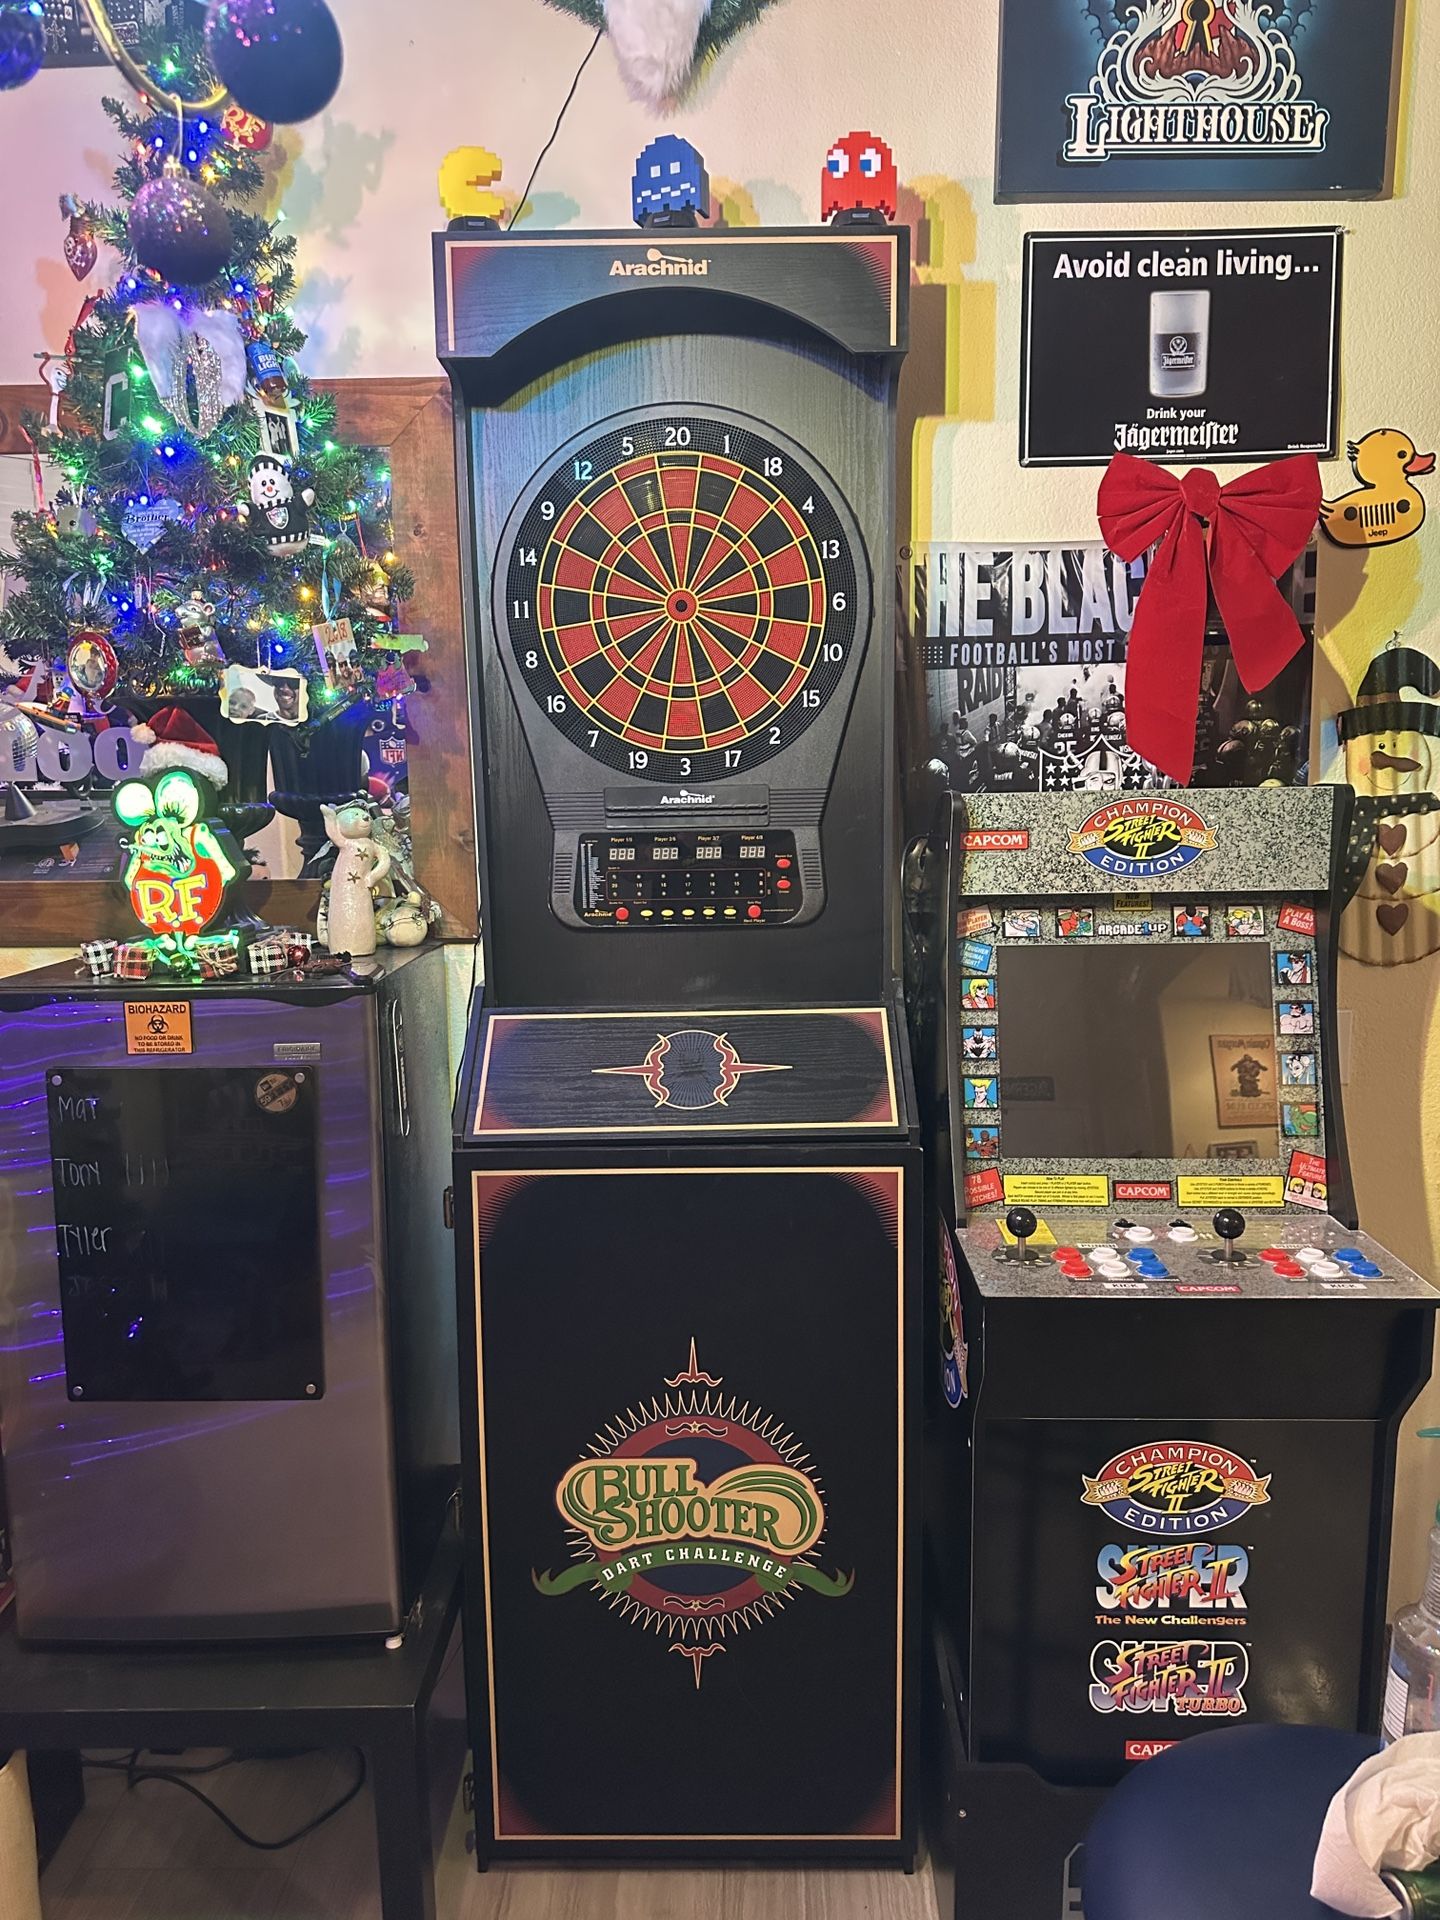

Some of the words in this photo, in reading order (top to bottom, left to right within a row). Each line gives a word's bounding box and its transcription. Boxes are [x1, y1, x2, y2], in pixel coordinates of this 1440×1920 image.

[1067, 97, 1327, 158] LIGHTHOUSE
[608, 258, 709, 277] Arachnid
[1053, 250, 1130, 279] Avoid
[1137, 250, 1208, 277] clean
[1216, 248, 1319, 280] living...
[258, 360, 280, 371] LIGH
[1146, 407, 1177, 420] Drink
[1180, 408, 1206, 421] your
[621, 436, 634, 454] 5
[663, 426, 691, 447] 20
[723, 434, 731, 453] 1
[574, 460, 592, 480] 12
[763, 456, 783, 476] 18
[540, 501, 555, 521] 9
[802, 495, 815, 514] 4
[1368, 529, 1388, 537] Jeep
[518, 547, 537, 567] 14
[821, 539, 840, 559] 13
[832, 592, 847, 611] 6
[1012, 549, 1146, 635] BLAC
[513, 600, 530, 619] 11
[525, 650, 539, 669] 8
[822, 643, 844, 662] 10
[950, 641, 1058, 666] FOOTBALL'S
[1068, 639, 1116, 663] MOST
[546, 694, 566, 713] 16
[802, 689, 820, 708] 15
[587, 729, 600, 748] 7
[769, 727, 781, 745] 2
[628, 751, 648, 770] 19
[680, 757, 691, 776] 3
[724, 750, 742, 768] 17
[660, 794, 713, 805] Arachnid
[1093, 802, 1193, 828] CHAMPION
[1103, 814, 1155, 843] STREET
[1121, 821, 1181, 846] FIGHTER
[963, 834, 1023, 847] CAPCOM
[1100, 853, 1185, 873] EDITION
[1285, 908, 1303, 918] PLAY
[1290, 918, 1314, 930] BOSS!
[128, 1004, 186, 1014] BIOHAZARD
[54, 1158, 101, 1187] Tony
[971, 1174, 982, 1185] 78
[965, 1189, 998, 1205] ATCHES!
[1118, 1186, 1167, 1197] CAPCOM
[58, 1224, 112, 1257] Tyler
[1115, 1447, 1238, 1475] CHAMPION
[1128, 1461, 1193, 1491] STREET
[1141, 1468, 1225, 1497] FIGHTER
[588, 1464, 699, 1515] BULL
[1161, 1494, 1193, 1514] II
[594, 1495, 788, 1550] SHOOTER
[1124, 1507, 1227, 1529] EDITION
[601, 1552, 653, 1582] DART
[665, 1547, 788, 1579] CHALLENGE
[1109, 1543, 1213, 1584] STREET
[1115, 1565, 1204, 1608] FIGHTER
[1095, 1614, 1121, 1625] The
[1125, 1614, 1158, 1625] New
[1161, 1614, 1247, 1625] Challengers
[1104, 1640, 1210, 1684] STREET
[1110, 1664, 1204, 1708] FIGHTER
[1176, 1697, 1242, 1713] TURBO
